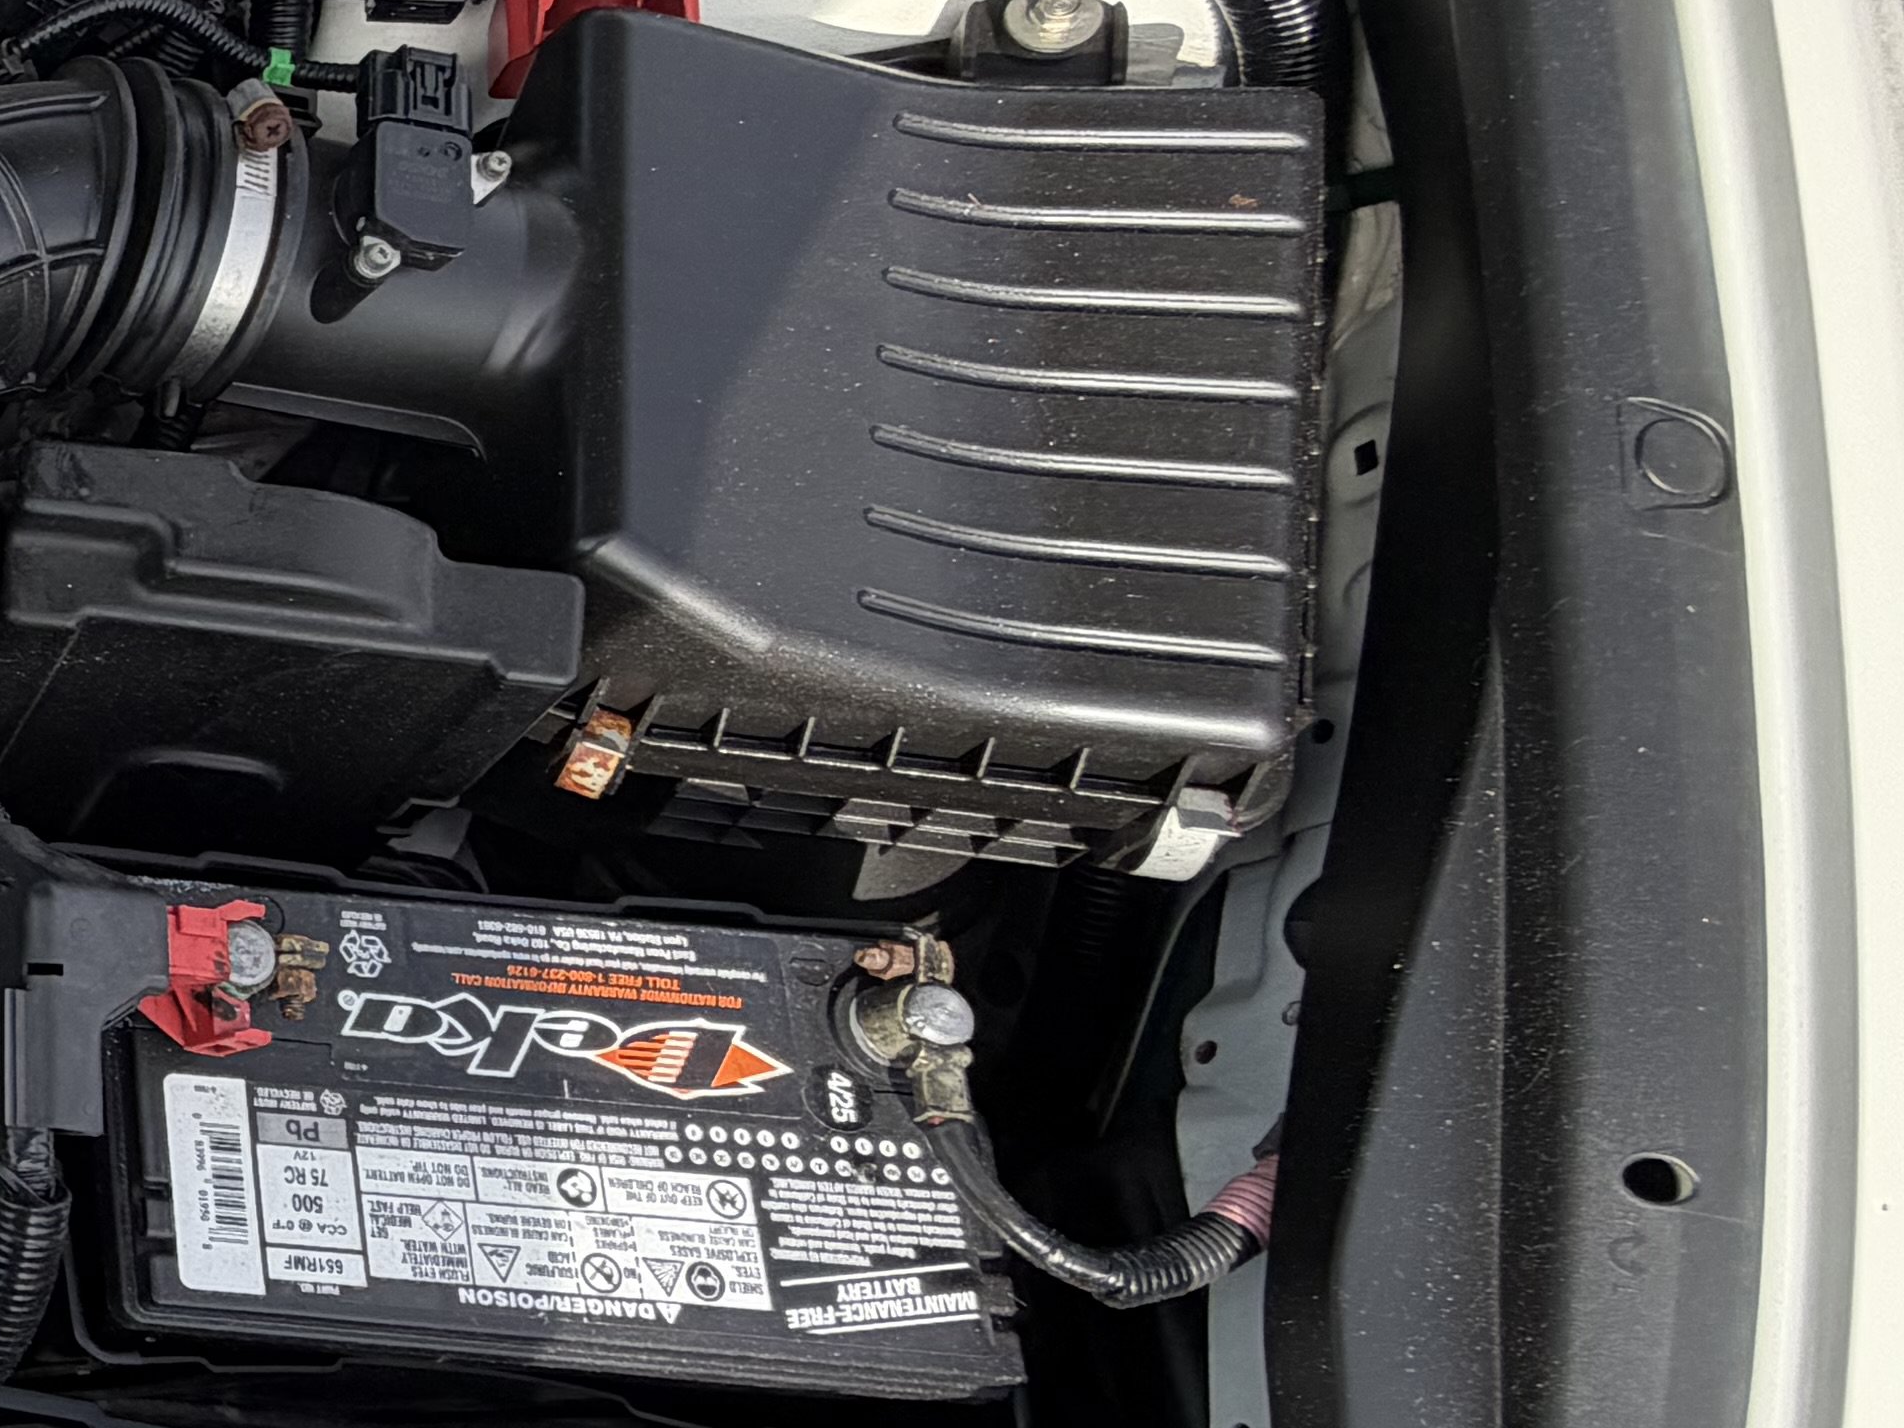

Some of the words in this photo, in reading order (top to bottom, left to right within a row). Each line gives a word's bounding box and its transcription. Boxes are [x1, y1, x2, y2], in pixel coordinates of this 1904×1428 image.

[552, 926, 574, 938] USA
[608, 931, 622, 943] PA
[503, 935, 529, 946] Deka
[663, 934, 689, 947] Lyon
[571, 941, 645, 958] Manufacturing
[646, 948, 671, 960] Penn
[507, 965, 604, 982] 1-800-237-6126
[608, 973, 643, 986] FREE
[484, 976, 567, 996] INFORMATION
[645, 976, 681, 991] TOLL
[568, 985, 638, 1001] WARRANTY
[639, 990, 717, 1008] NATIONWIDE
[718, 995, 743, 1010] FOR
[342, 992, 795, 1100] Deka
[827, 1072, 860, 1124] 4/25
[286, 1119, 321, 1142] Pb
[293, 1150, 317, 1161] 12V
[409, 1160, 430, 1173] TIP.
[431, 1162, 452, 1175] NOT
[454, 1164, 469, 1176] DO
[283, 1166, 306, 1185] RC
[308, 1167, 329, 1187] 75
[407, 1172, 432, 1186] OPEN
[433, 1174, 454, 1187] NOT
[455, 1176, 470, 1188] DO
[524, 1181, 550, 1194] READ
[607, 1177, 654, 1191] CHILDREN
[656, 1181, 668, 1193] OF
[670, 1182, 702, 1195] REACH
[625, 1190, 643, 1202] THE
[644, 1192, 658, 1203] OF
[659, 1192, 678, 1204] OUT
[680, 1193, 704, 1207] KEEP
[292, 1193, 323, 1214] 500
[393, 1202, 422, 1216] HELP
[369, 1213, 412, 1228] MEDICAL
[521, 1215, 552, 1229] SEVERE
[554, 1218, 566, 1229] OR
[316, 1222, 347, 1236] CCA
[370, 1226, 388, 1238] GET
[472, 1224, 518, 1239] BLINDNESS
[519, 1227, 546, 1240] CAUSE
[546, 1229, 568, 1241] CAN
[657, 1230, 706, 1244] BLINDNESS
[400, 1239, 437, 1253] WATER.
[438, 1241, 466, 1255] WITH
[669, 1244, 701, 1258] GASES
[401, 1252, 468, 1269] IMMEDIATELY
[547, 1251, 571, 1264] ACID
[703, 1247, 758, 1262] EXPLOSIVE
[283, 1254, 344, 1275] 651RMF
[411, 1265, 435, 1278] EYES
[526, 1263, 573, 1278] SULFURIC
[438, 1267, 470, 1282] FLUSH
[623, 1268, 637, 1279] NO
[729, 1282, 764, 1296] SHIELD
[835, 1277, 923, 1302] BATTERY
[458, 1288, 656, 1320] DANGER/POISON
[785, 1290, 977, 1329] MAINTENANCE-FREE
